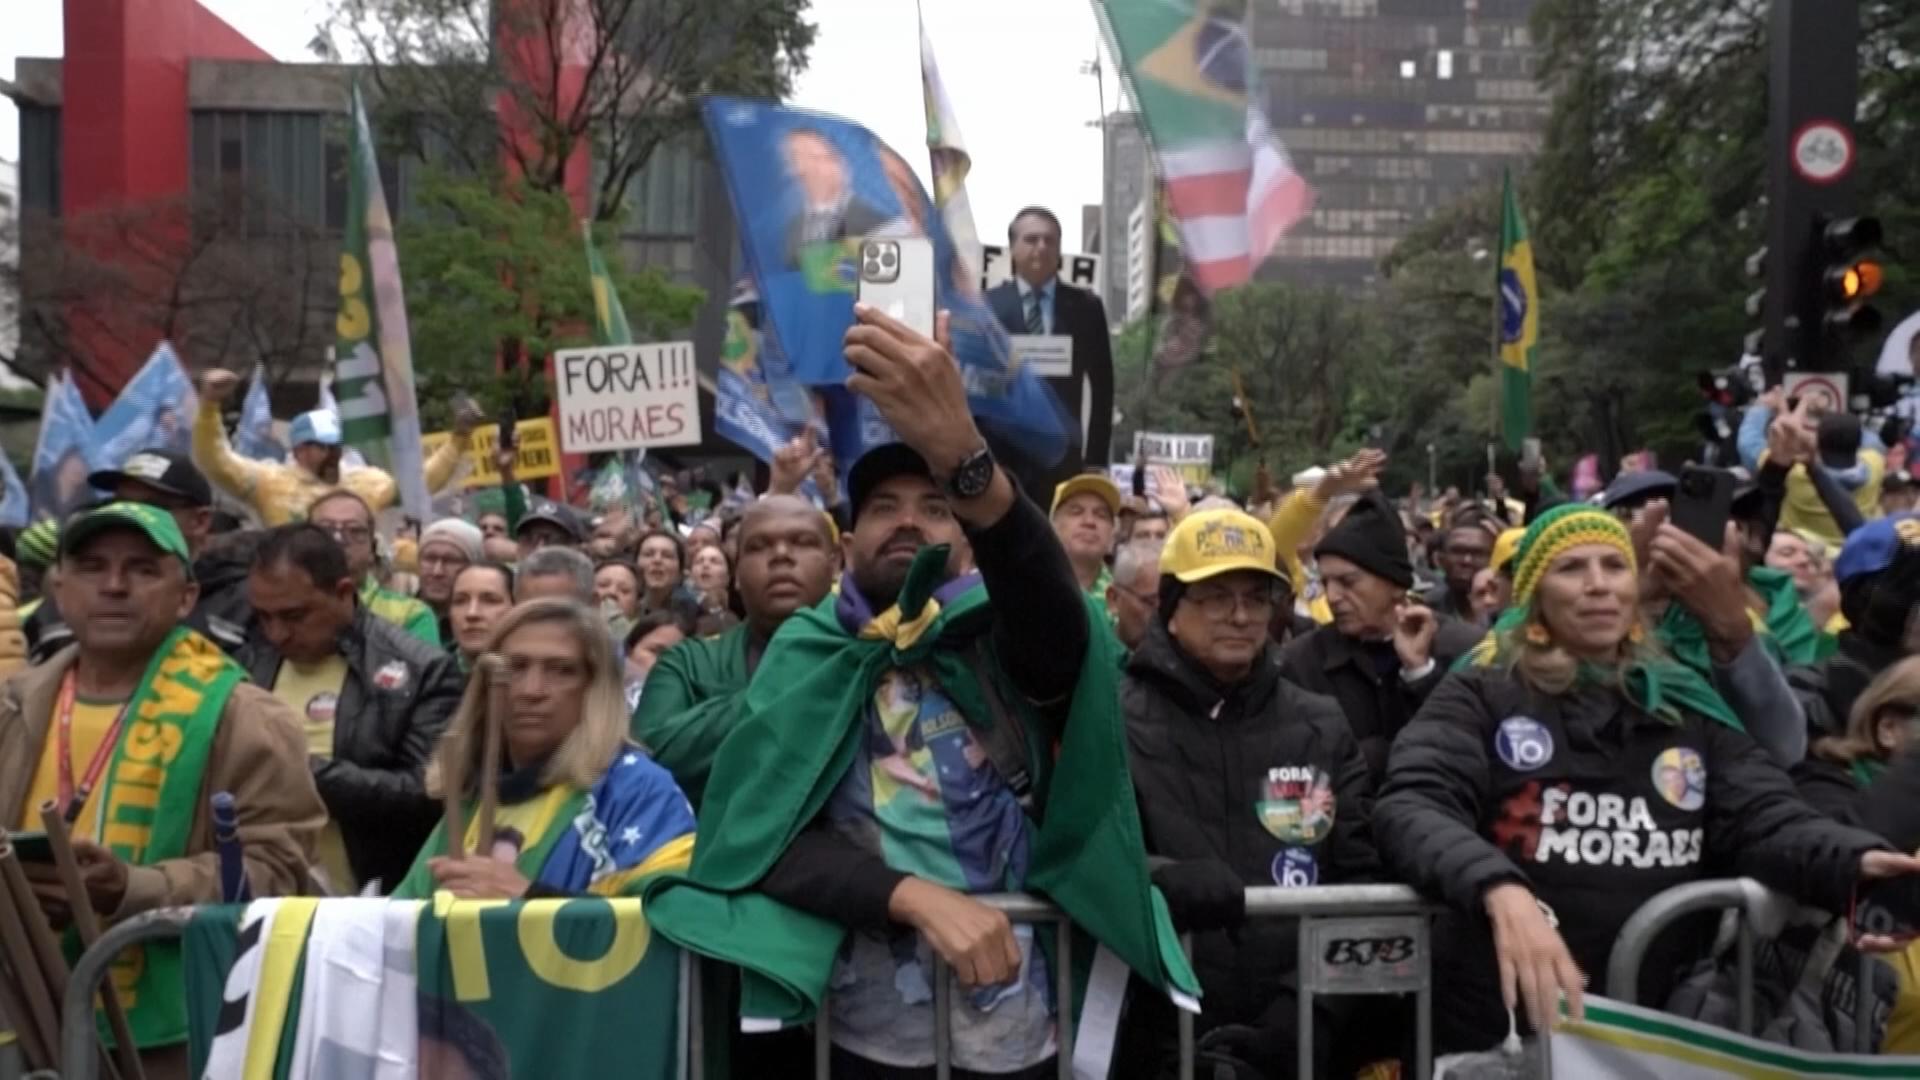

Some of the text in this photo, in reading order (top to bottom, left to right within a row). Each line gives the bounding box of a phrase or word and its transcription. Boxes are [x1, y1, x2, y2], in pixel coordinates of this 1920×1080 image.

[568, 402, 685, 445] MORAES
[1268, 766, 1312, 782] FORA
[1534, 828, 1704, 868] MORAES
